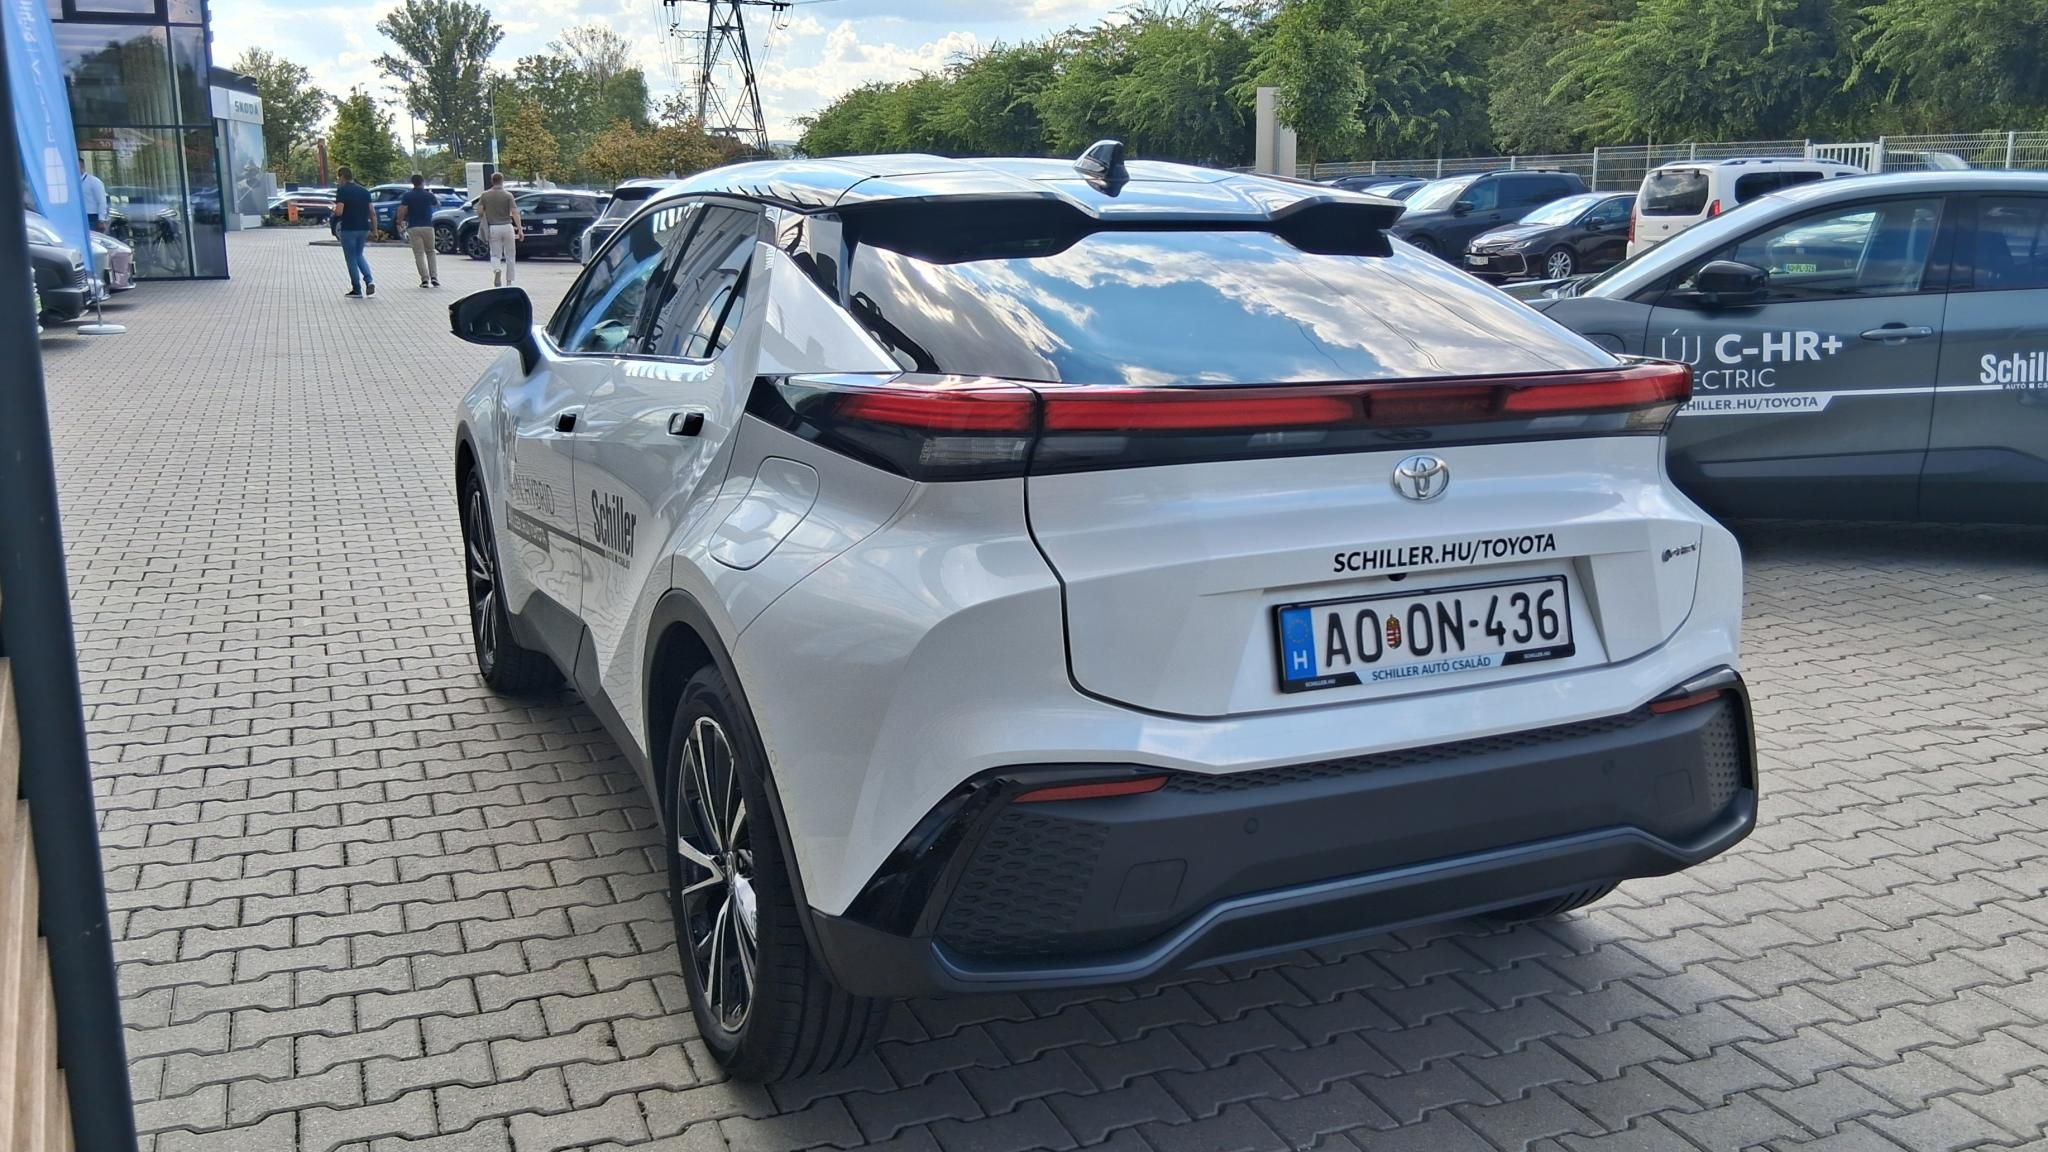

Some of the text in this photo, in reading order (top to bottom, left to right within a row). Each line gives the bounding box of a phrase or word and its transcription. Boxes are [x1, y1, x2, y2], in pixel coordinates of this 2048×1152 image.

[1715, 331, 1843, 364] C-HR+
[591, 488, 637, 558] Schiller
[1333, 532, 1556, 573] SCHILLER.HU/TOYOTA
[1292, 588, 1559, 670] H AO ON-436
[1371, 655, 1491, 682] SCHILLER AUTÓ CSALÁD
